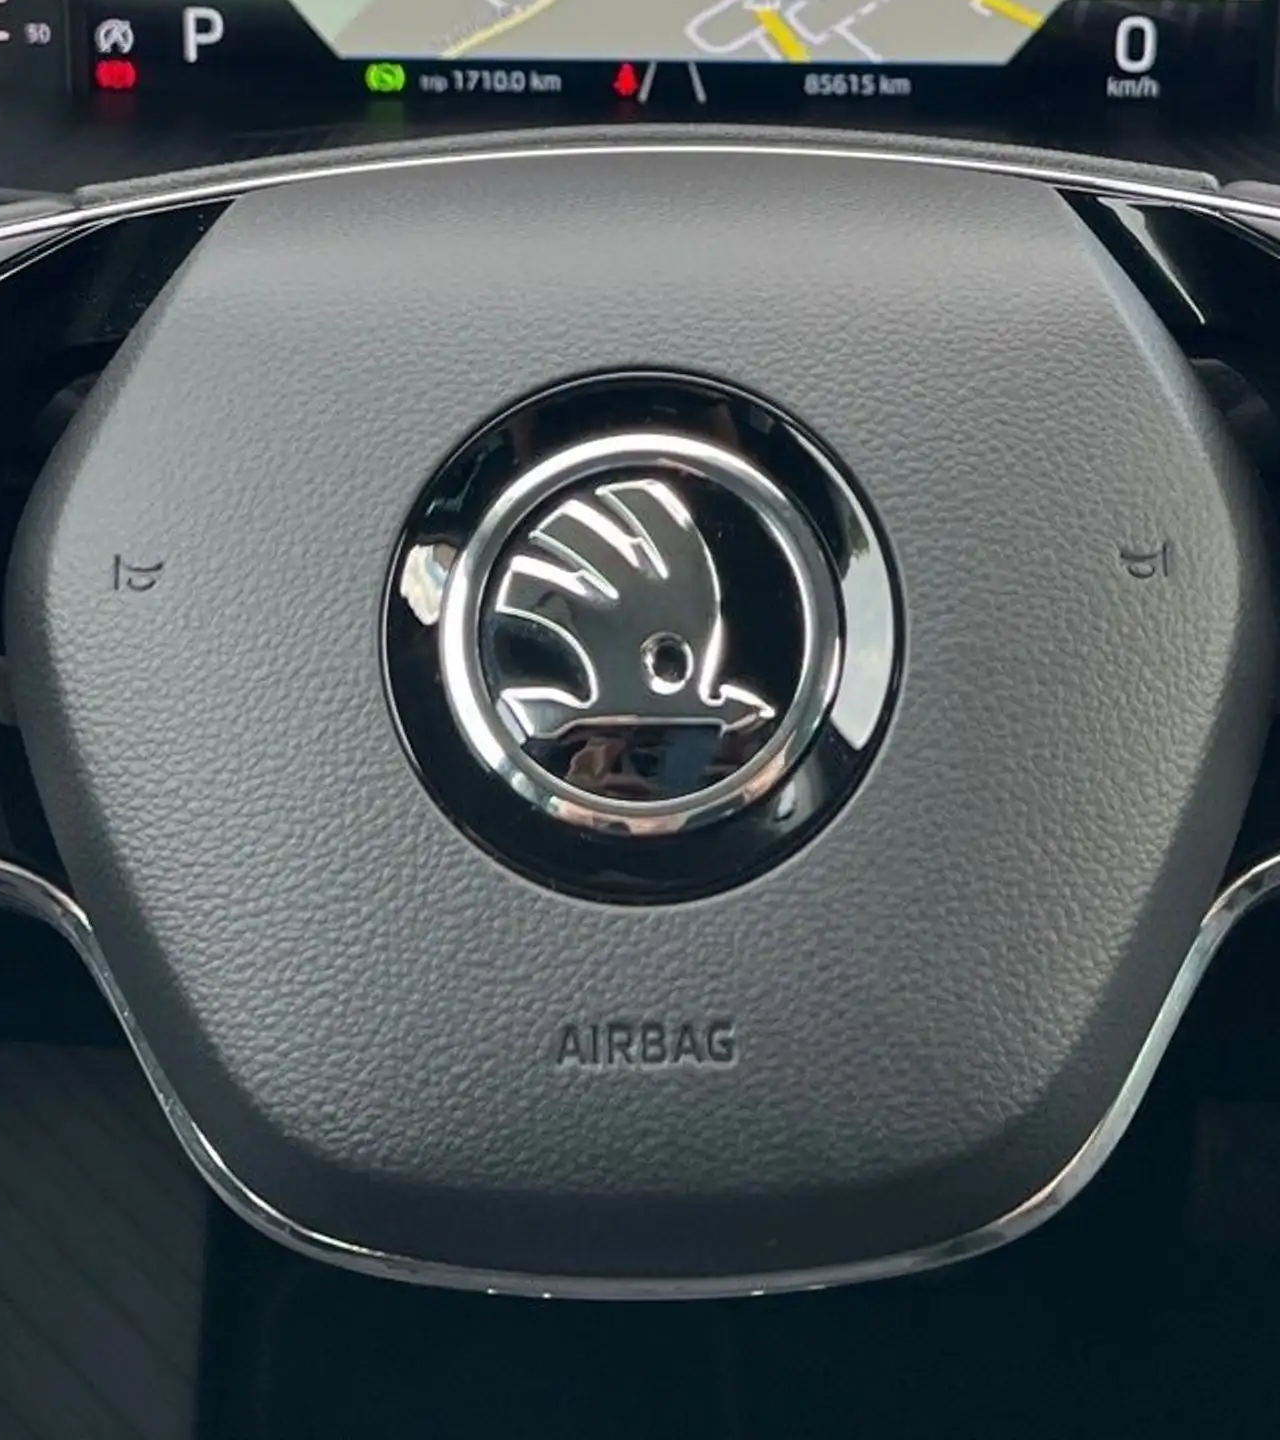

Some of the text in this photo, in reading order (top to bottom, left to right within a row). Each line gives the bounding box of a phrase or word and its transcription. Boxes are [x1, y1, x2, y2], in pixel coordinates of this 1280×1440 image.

[23, 22, 51, 45] 50
[182, 5, 224, 63] P
[1114, 14, 1158, 74] 0
[529, 70, 562, 93] km
[803, 72, 912, 96] 85615 km
[1106, 75, 1160, 98] km/h
[556, 1021, 737, 1067] AIRBAG
